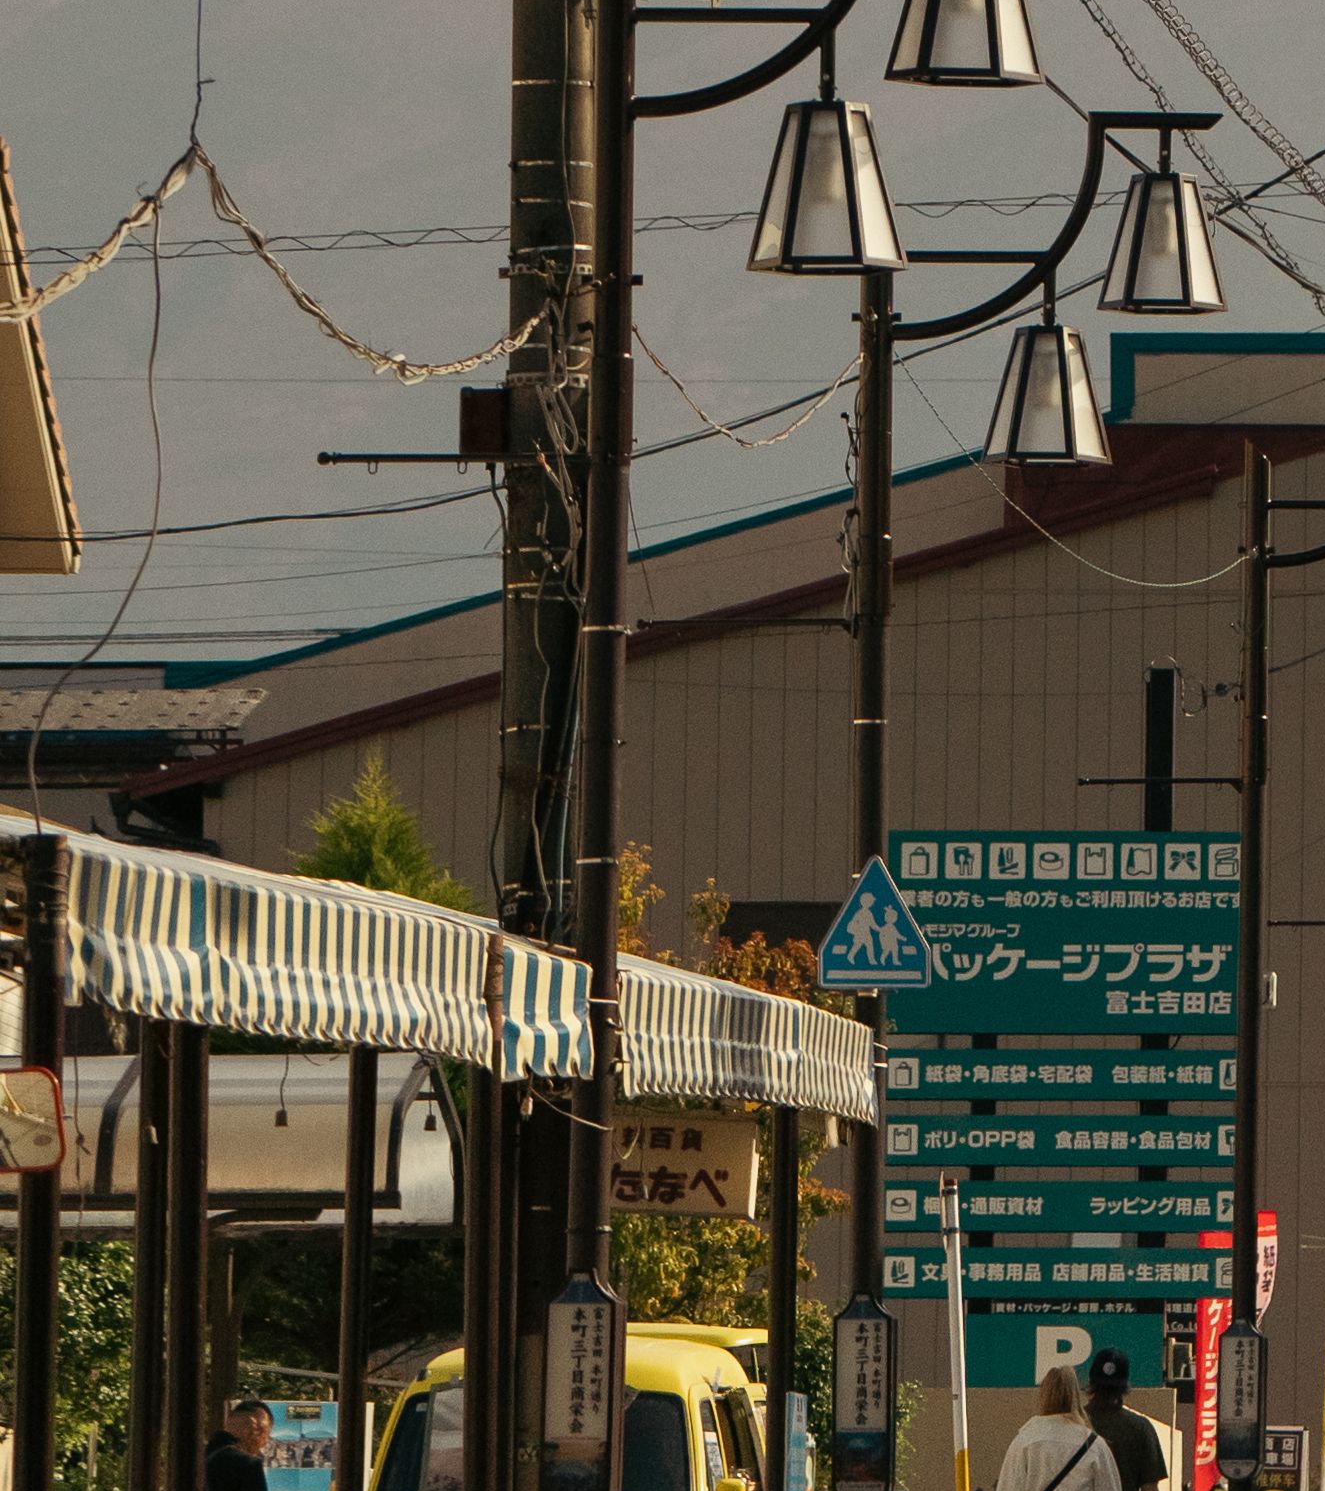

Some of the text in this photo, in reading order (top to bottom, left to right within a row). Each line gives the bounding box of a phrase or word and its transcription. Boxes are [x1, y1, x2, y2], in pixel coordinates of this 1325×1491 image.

[933, 943, 1232, 983] パッケージプラザ
[1106, 991, 1232, 1015] 富士吉田店
[926, 1064, 1213, 1086] 紙袋・角底袋・宅配袋 包装紙・紙箱
[925, 1130, 1212, 1151] ポリ・OPP袋 食品容器・食品包材
[924, 1196, 1211, 1217] 梱・通販資材 ラッピング用品
[1053, 1263, 1209, 1283] 店舗用品・生活雑貨
[1035, 1325, 1092, 1385] P
[568, 1307, 588, 1434] 本町三丁目商栄会
